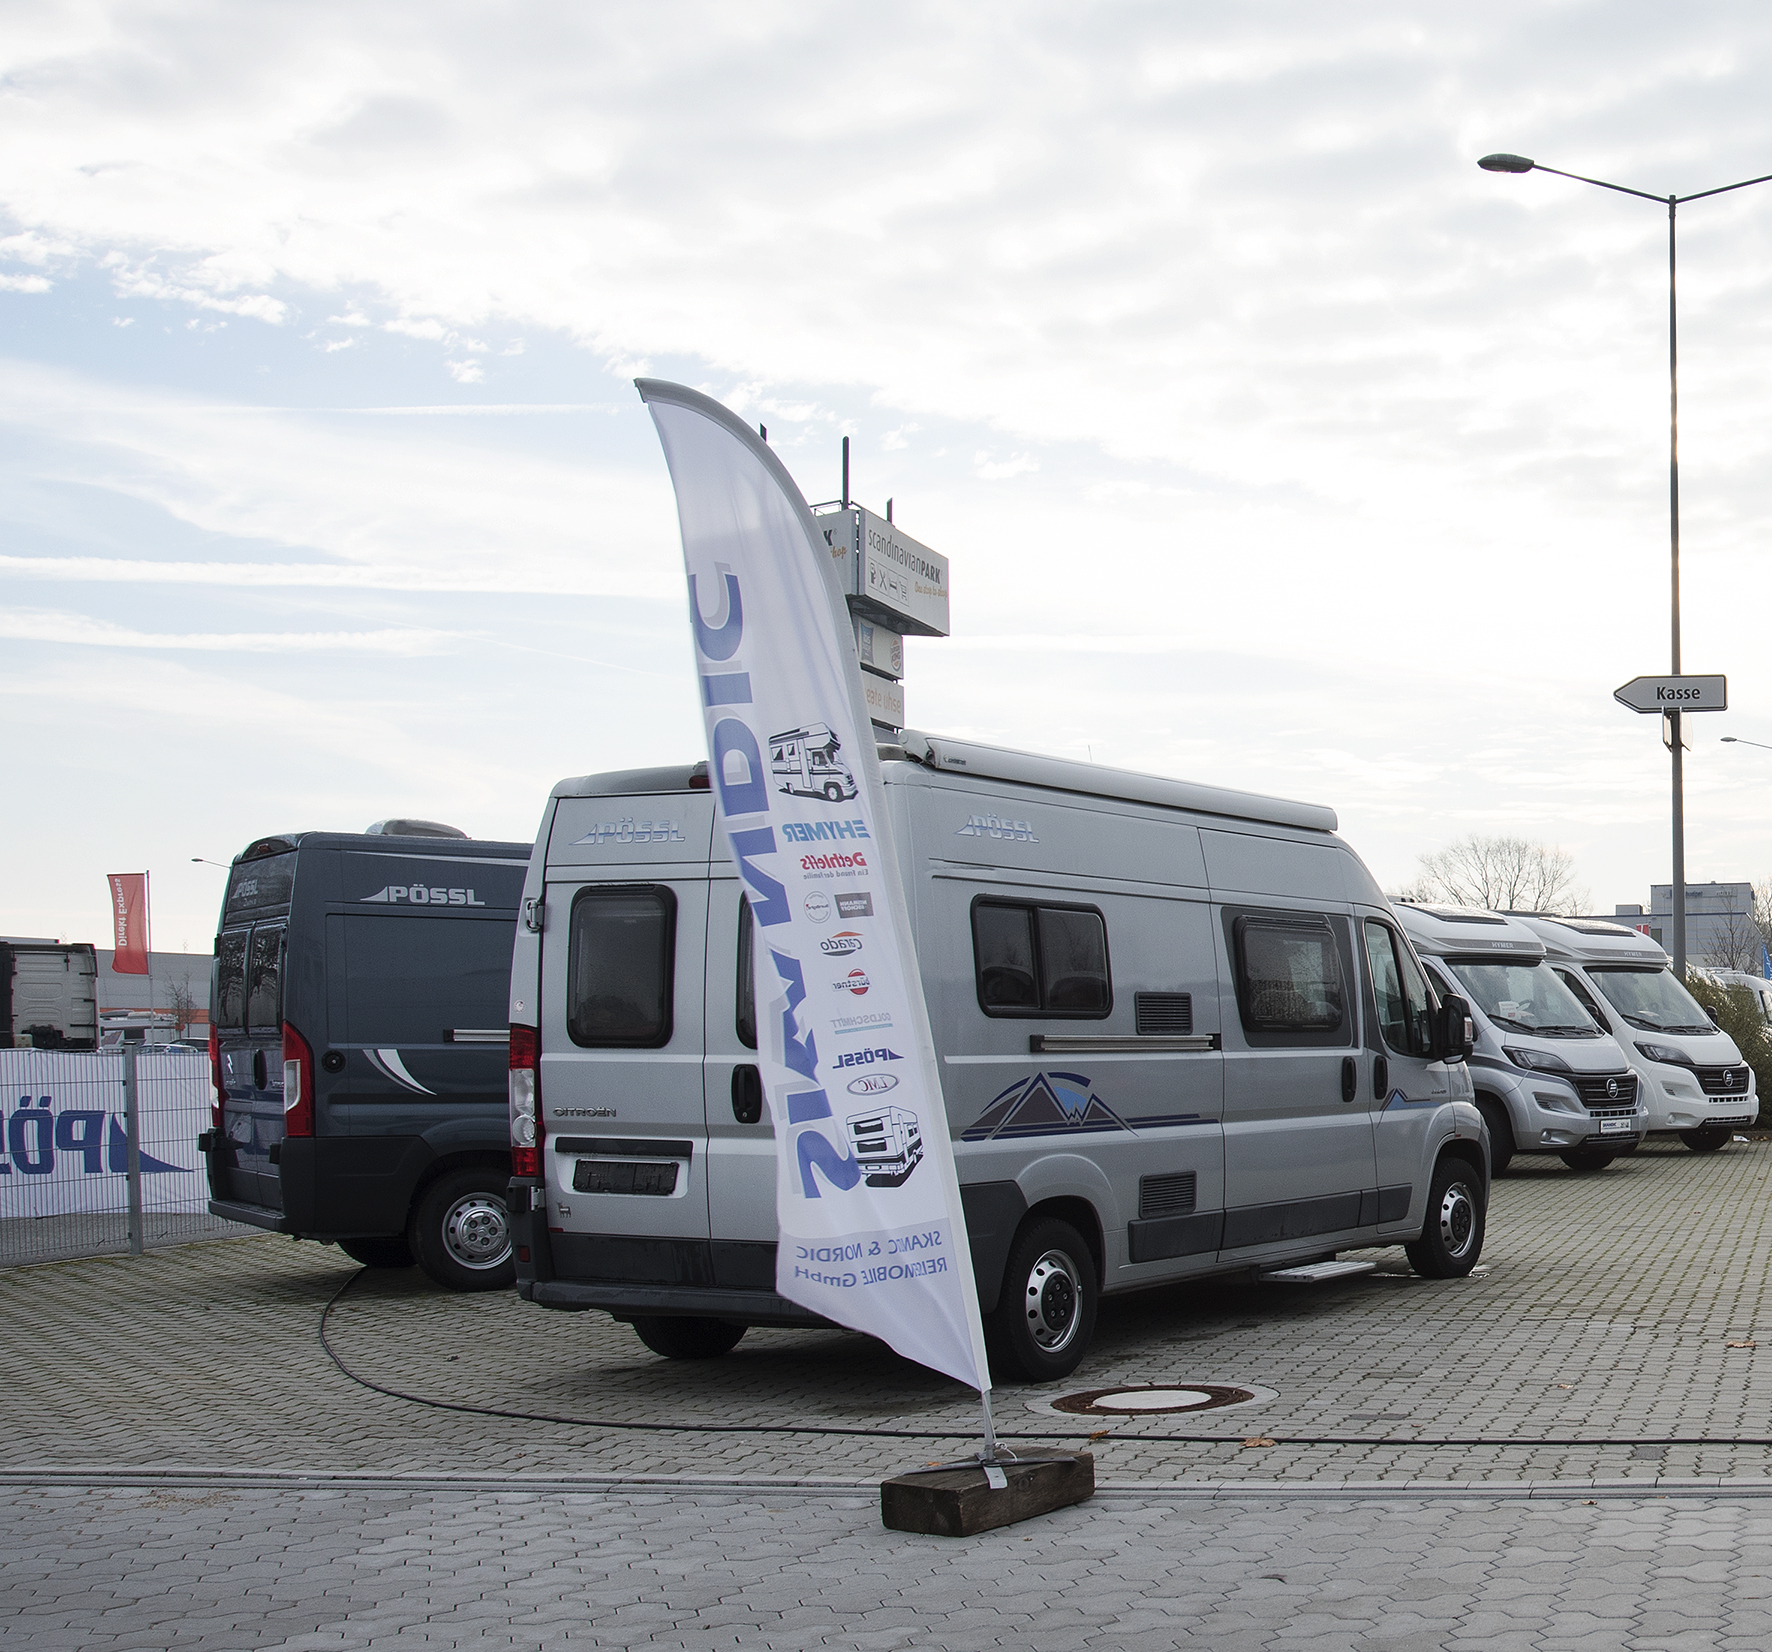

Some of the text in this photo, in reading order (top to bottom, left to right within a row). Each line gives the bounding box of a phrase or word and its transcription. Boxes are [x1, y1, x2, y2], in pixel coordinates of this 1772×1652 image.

[830, 546, 847, 560] hop
[865, 688, 901, 714] eate uhse
[1656, 687, 1701, 700] Kasse
[597, 817, 686, 845] PÖSSL
[971, 812, 1040, 844] PÖSSL
[388, 883, 486, 906] PÖSSL
[552, 1106, 617, 1118] CITROËN
